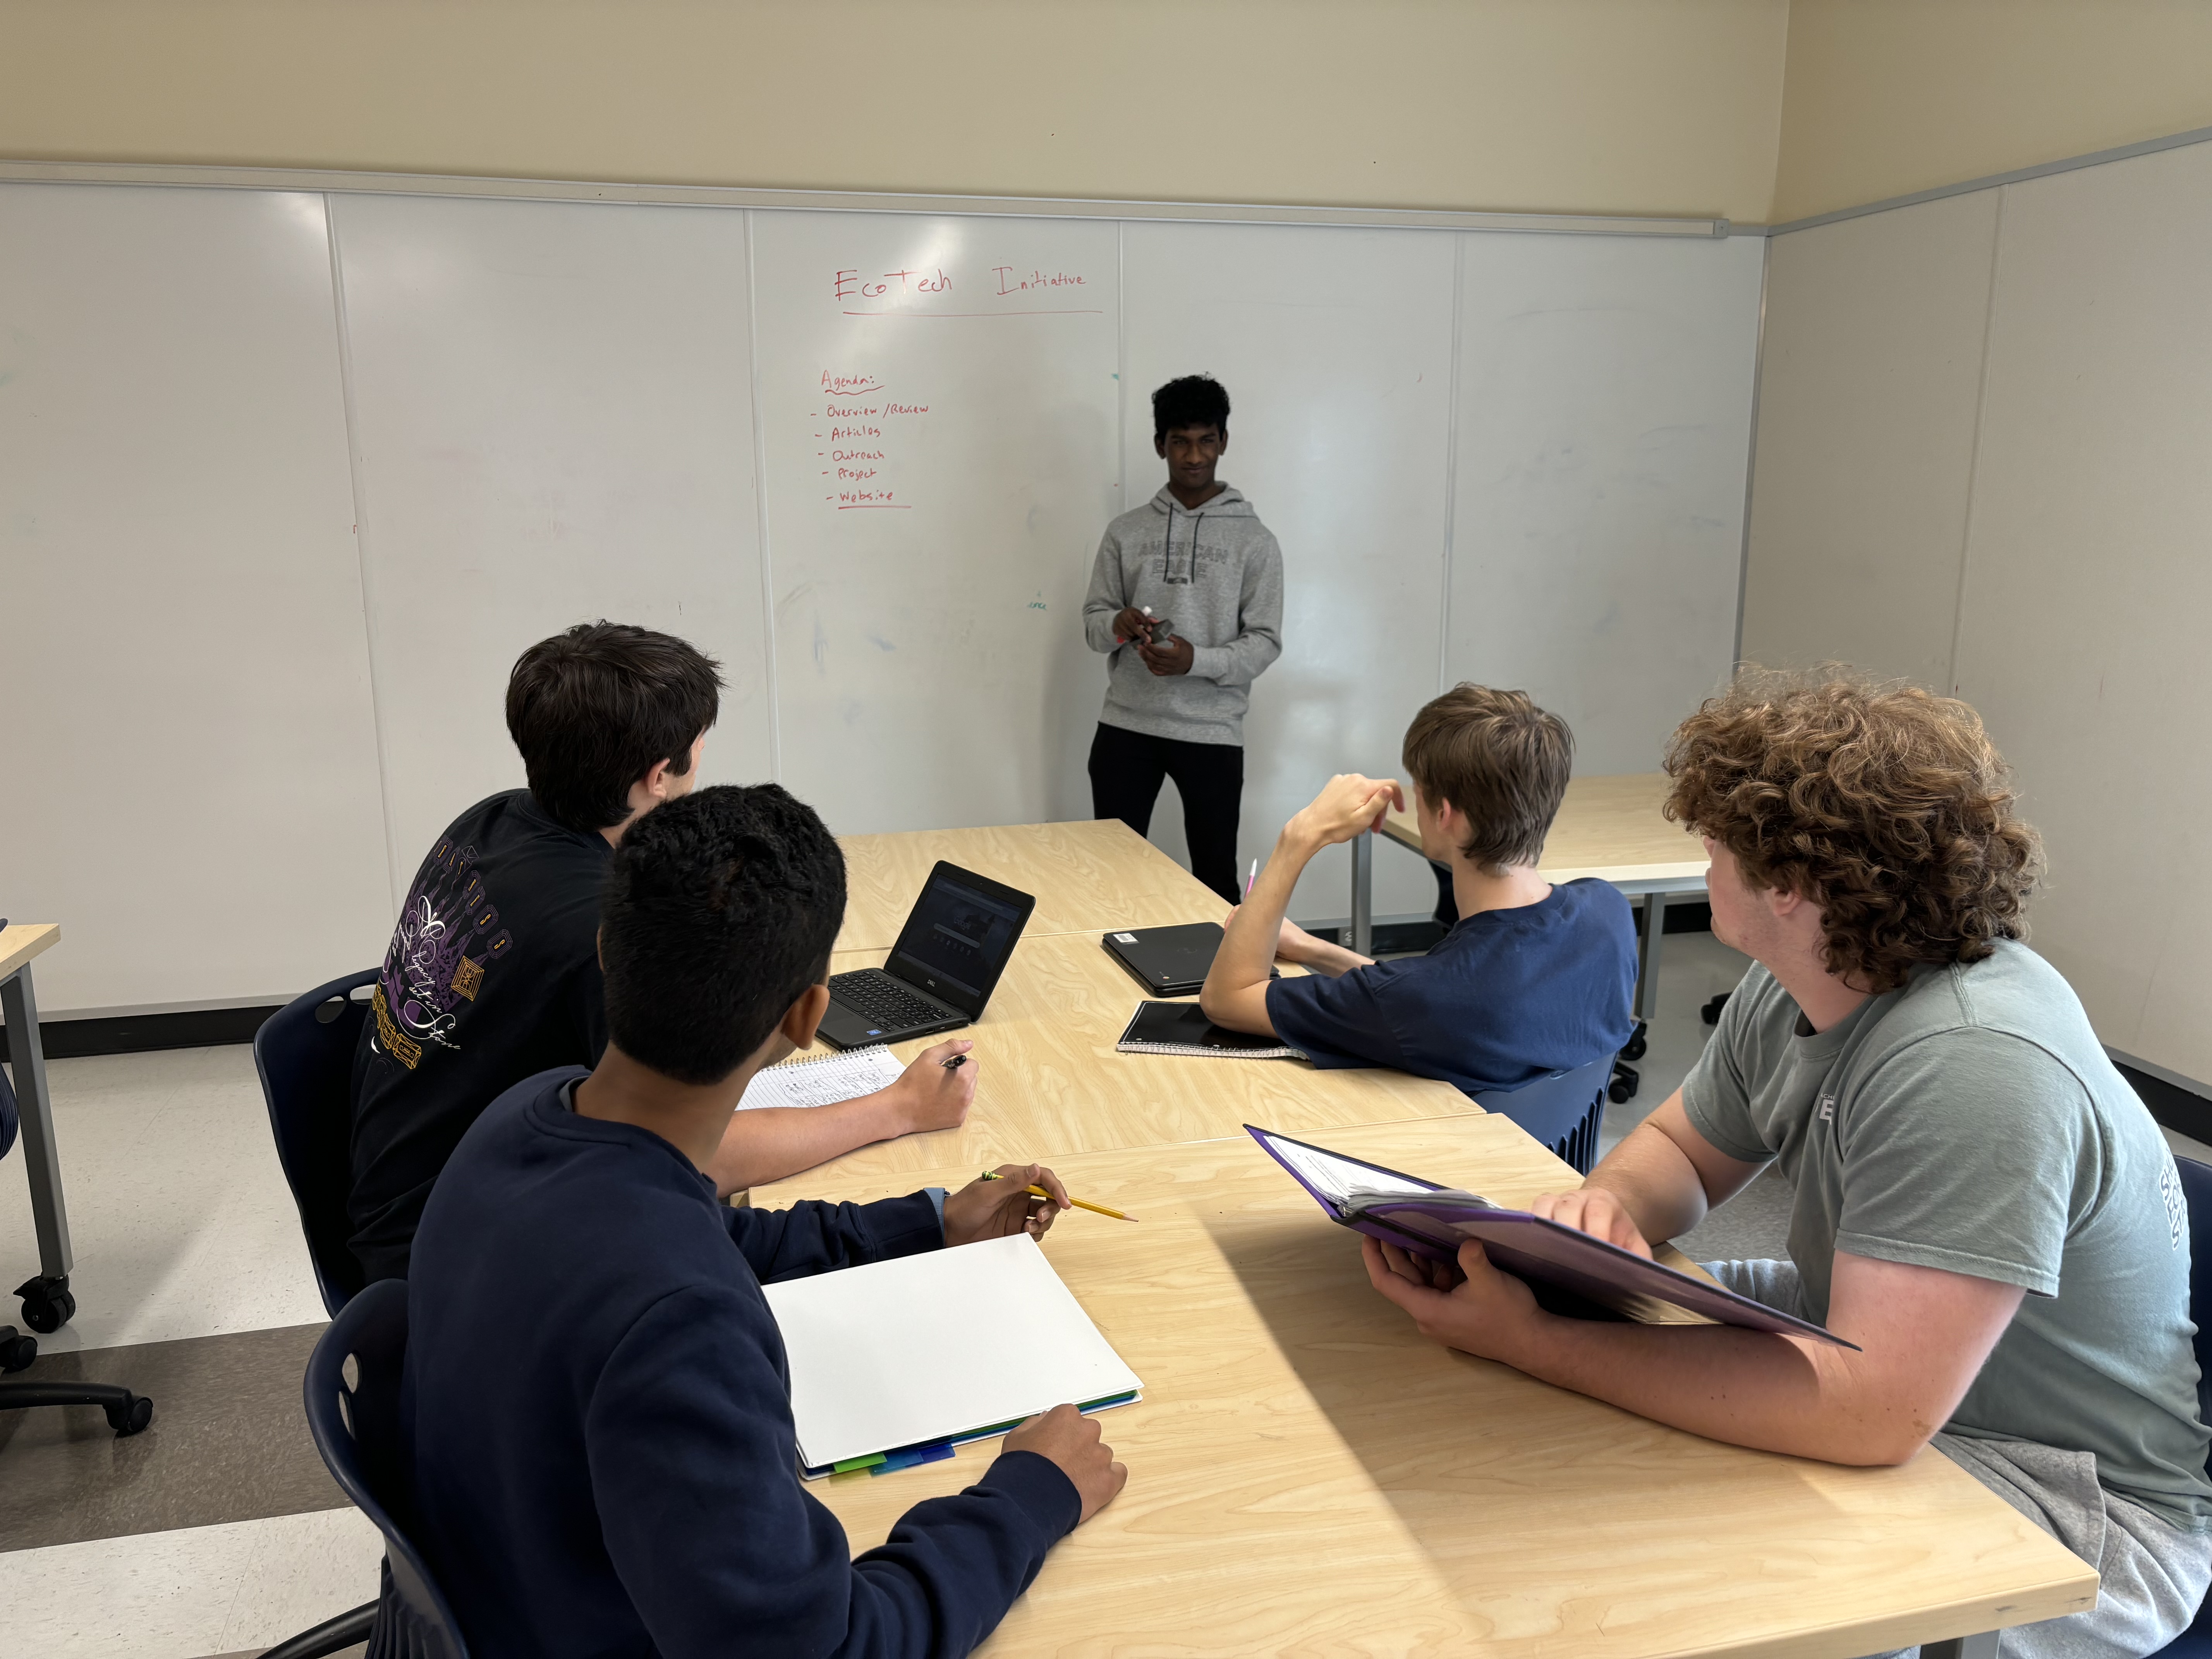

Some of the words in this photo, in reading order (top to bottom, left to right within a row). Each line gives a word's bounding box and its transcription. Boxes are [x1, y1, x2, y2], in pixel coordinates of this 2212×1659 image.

[835, 268, 953, 301] EcoTech
[992, 266, 1087, 296] Initiative
[821, 369, 876, 391] Agenda:
[831, 425, 881, 443] Articles
[832, 450, 886, 462] Outreach
[839, 489, 894, 504] Website
[1138, 540, 1229, 565] AMERICAN
[405, 950, 436, 987] legacy
[927, 979, 936, 987] DELL
[409, 987, 434, 1000] set
